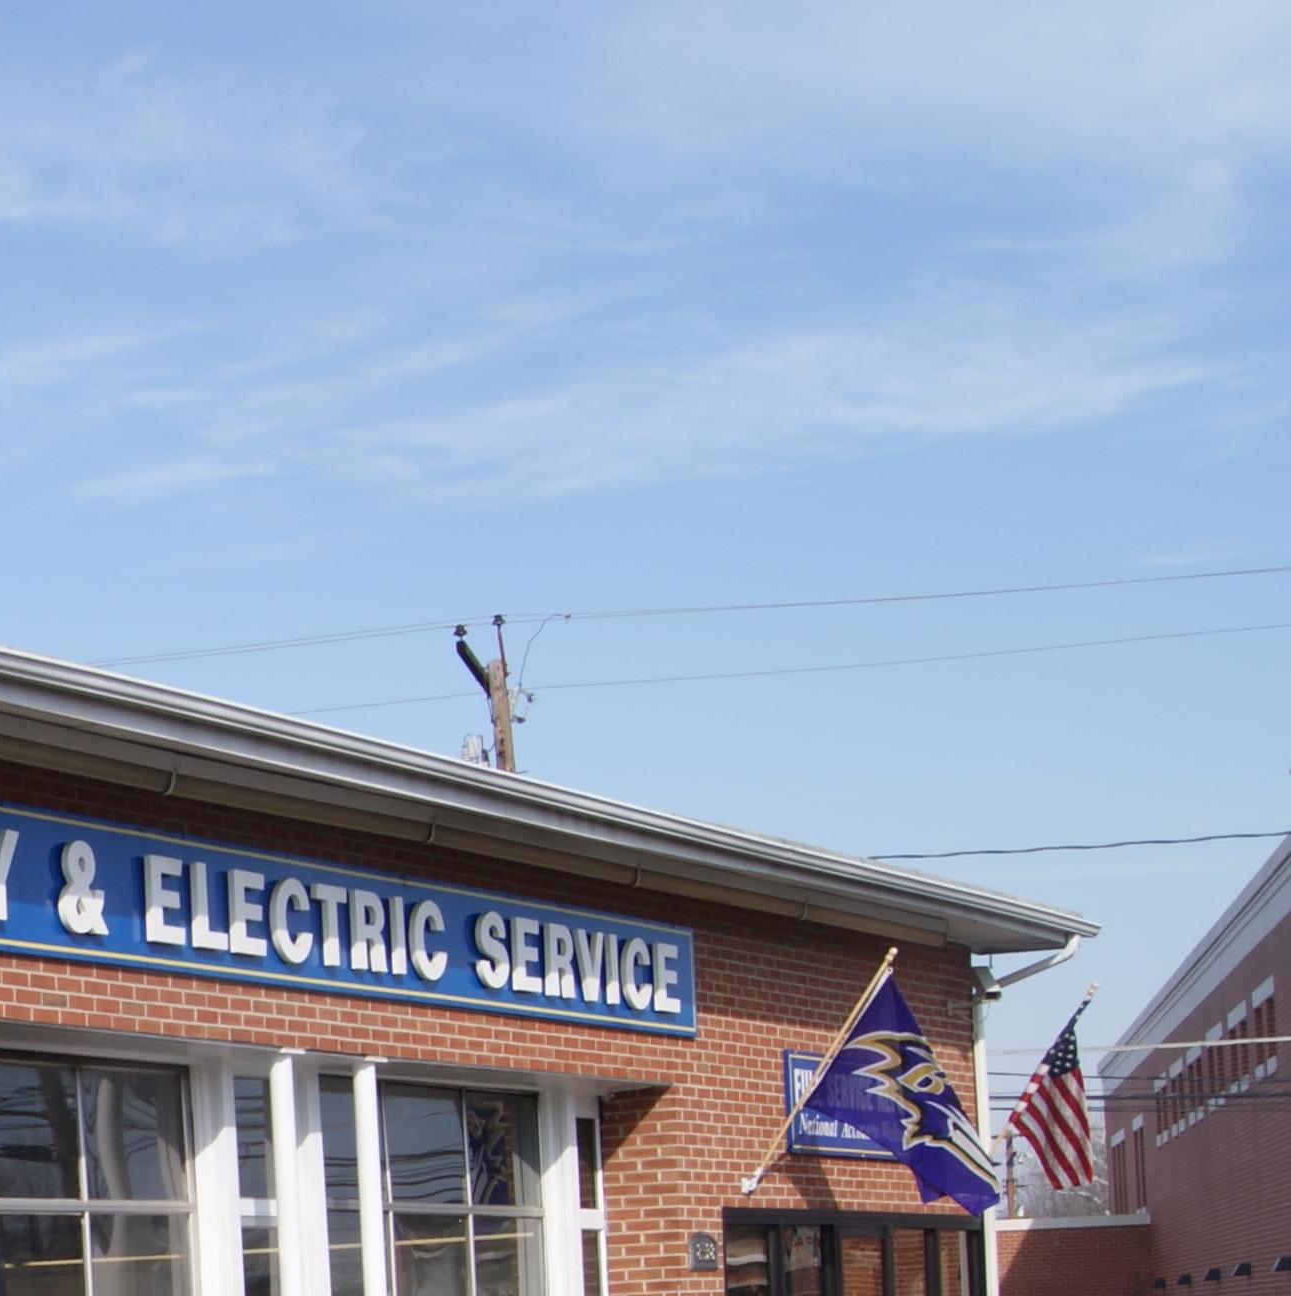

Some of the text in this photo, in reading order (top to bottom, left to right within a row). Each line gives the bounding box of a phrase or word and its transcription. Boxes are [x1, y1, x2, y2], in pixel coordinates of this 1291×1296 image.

[57, 840, 109, 936] &
[143, 853, 448, 982] ELECTRIC
[473, 910, 681, 1014] SERVICE
[799, 1112, 838, 1138] National
